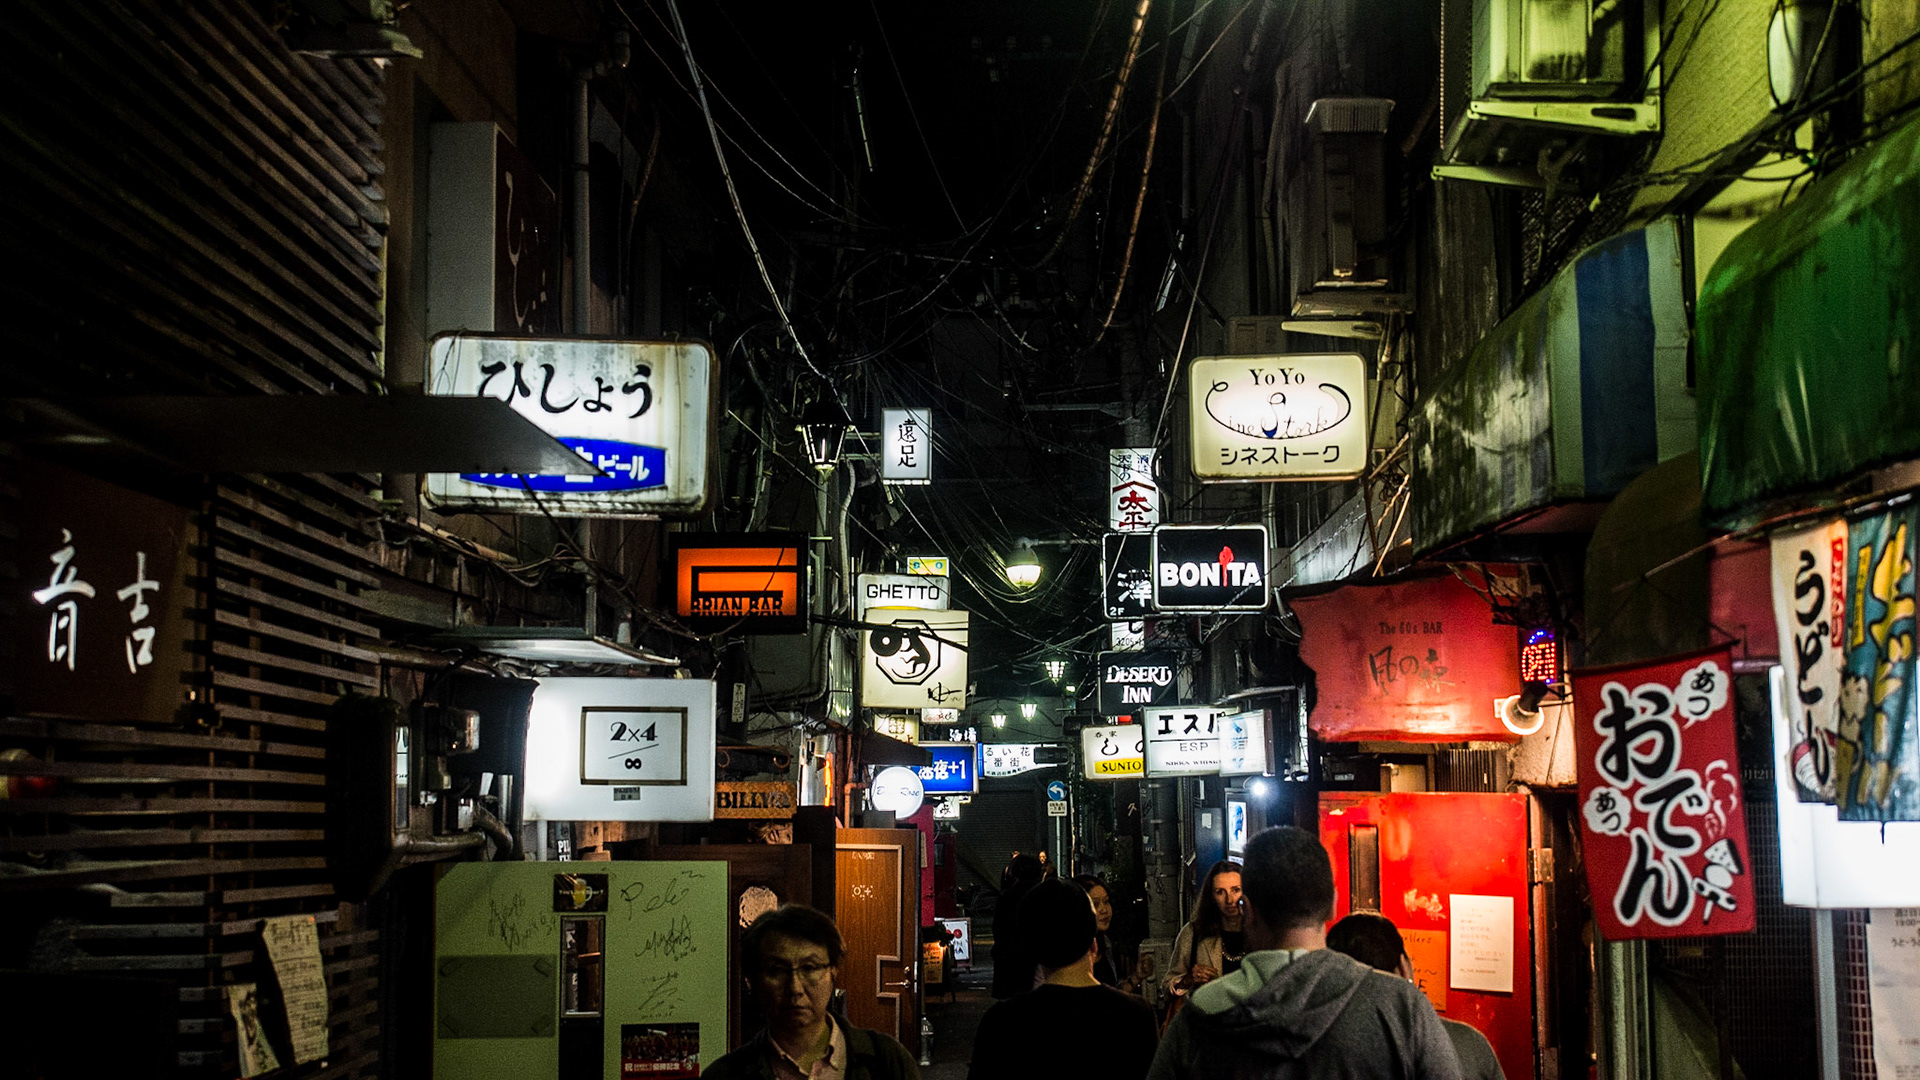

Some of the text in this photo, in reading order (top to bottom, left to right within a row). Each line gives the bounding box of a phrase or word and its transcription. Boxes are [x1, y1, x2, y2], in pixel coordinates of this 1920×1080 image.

[479, 360, 652, 418] ひしょう
[898, 418, 918, 468] 遠足
[1221, 446, 1340, 466] シネストーク
[1160, 546, 1263, 588] BONITA
[866, 583, 941, 601] GHETTO
[691, 597, 783, 616] BRIAN BAR
[1110, 607, 1125, 616] 2F
[1423, 621, 1443, 634] BAR
[1105, 665, 1172, 686] DESERT
[1122, 685, 1152, 704] INN
[1688, 669, 1717, 716] あつ
[1179, 742, 1209, 753] ESP
[1102, 760, 1144, 772] SUNTO
[1596, 791, 1622, 832] あつ
[1600, 688, 1696, 921] おでん
